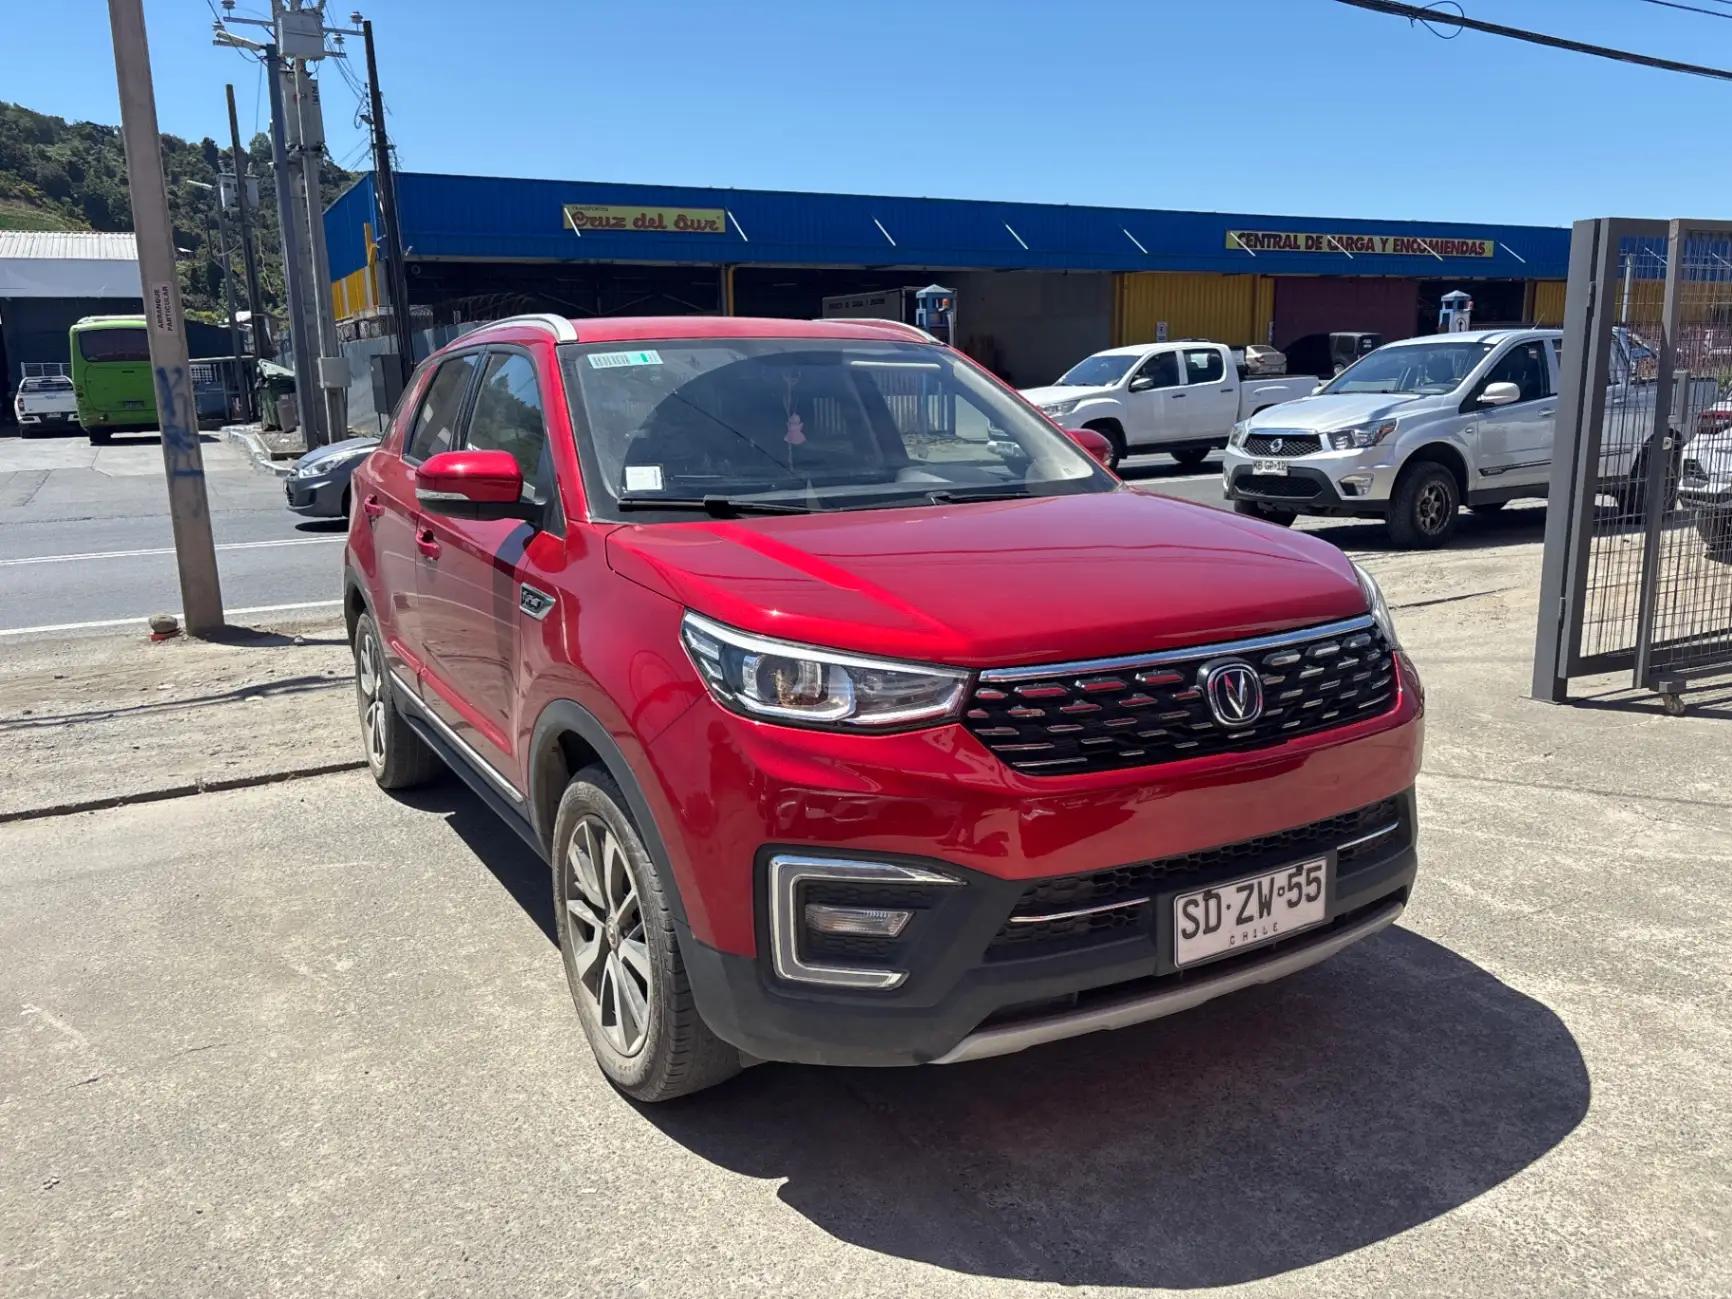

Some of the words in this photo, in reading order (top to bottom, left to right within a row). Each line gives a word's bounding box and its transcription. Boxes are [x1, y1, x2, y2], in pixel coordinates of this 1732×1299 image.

[571, 211, 626, 228] Cruz
[632, 212, 668, 229] del
[673, 214, 720, 231] Sur
[1237, 232, 1301, 250] CENTRAL
[1304, 235, 1325, 250] DE
[1327, 235, 1376, 252] CARGA
[1379, 238, 1389, 252] Y
[1392, 238, 1486, 256] ENCOMIENDAS
[162, 286, 173, 331] PARTICULAR
[1229, 922, 1278, 945] CHILE
